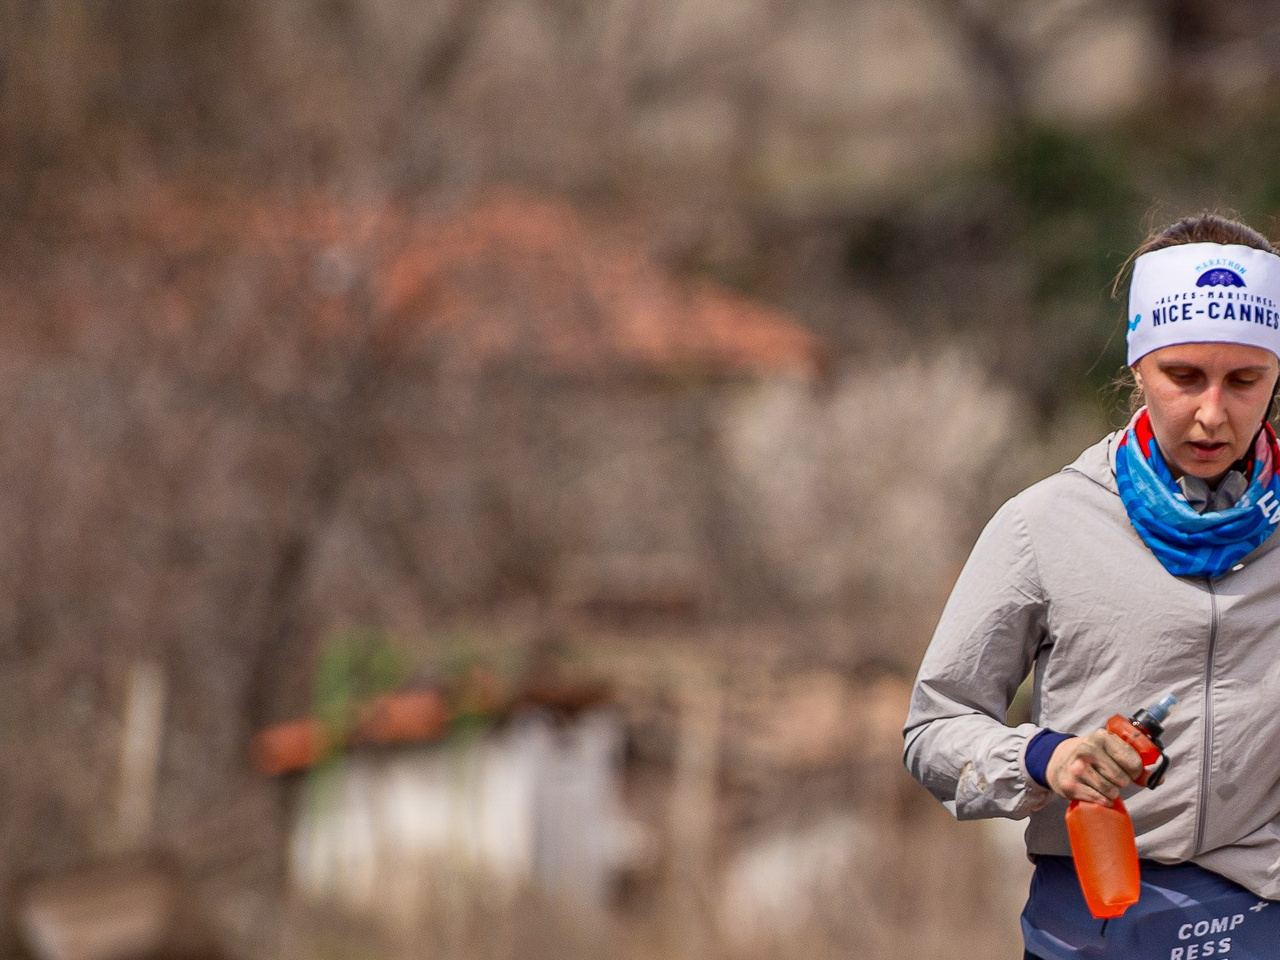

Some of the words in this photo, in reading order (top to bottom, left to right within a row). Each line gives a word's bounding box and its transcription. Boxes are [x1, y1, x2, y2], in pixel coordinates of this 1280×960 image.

[1195, 258, 1247, 275] MARATHON
[1152, 302, 1280, 331] NICE-CANNES
[1178, 914, 1245, 940] COMP
